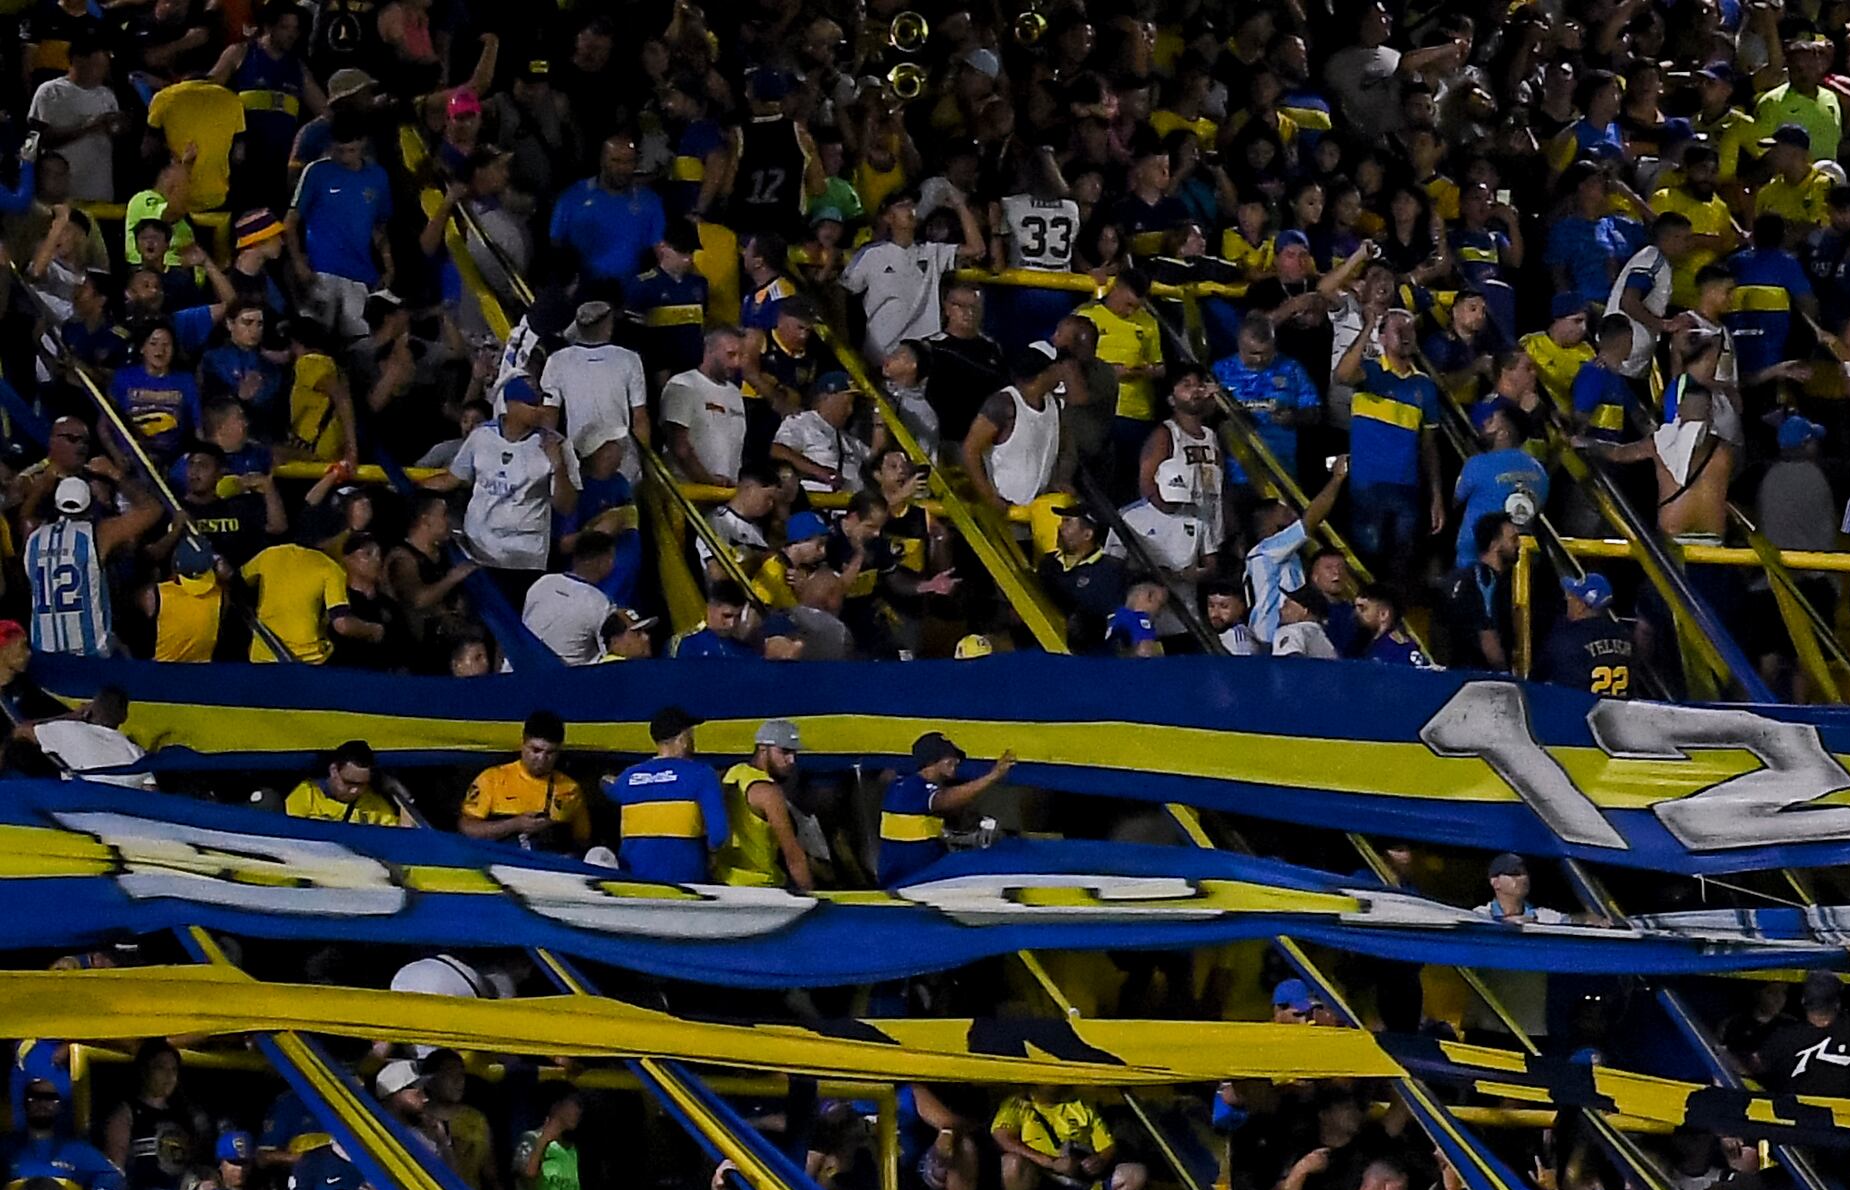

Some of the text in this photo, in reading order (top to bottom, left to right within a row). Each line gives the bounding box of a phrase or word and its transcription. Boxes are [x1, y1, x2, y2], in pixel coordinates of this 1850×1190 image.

[1021, 216, 1072, 259] 33
[37, 557, 83, 614] 12
[1590, 665, 1631, 697] 22
